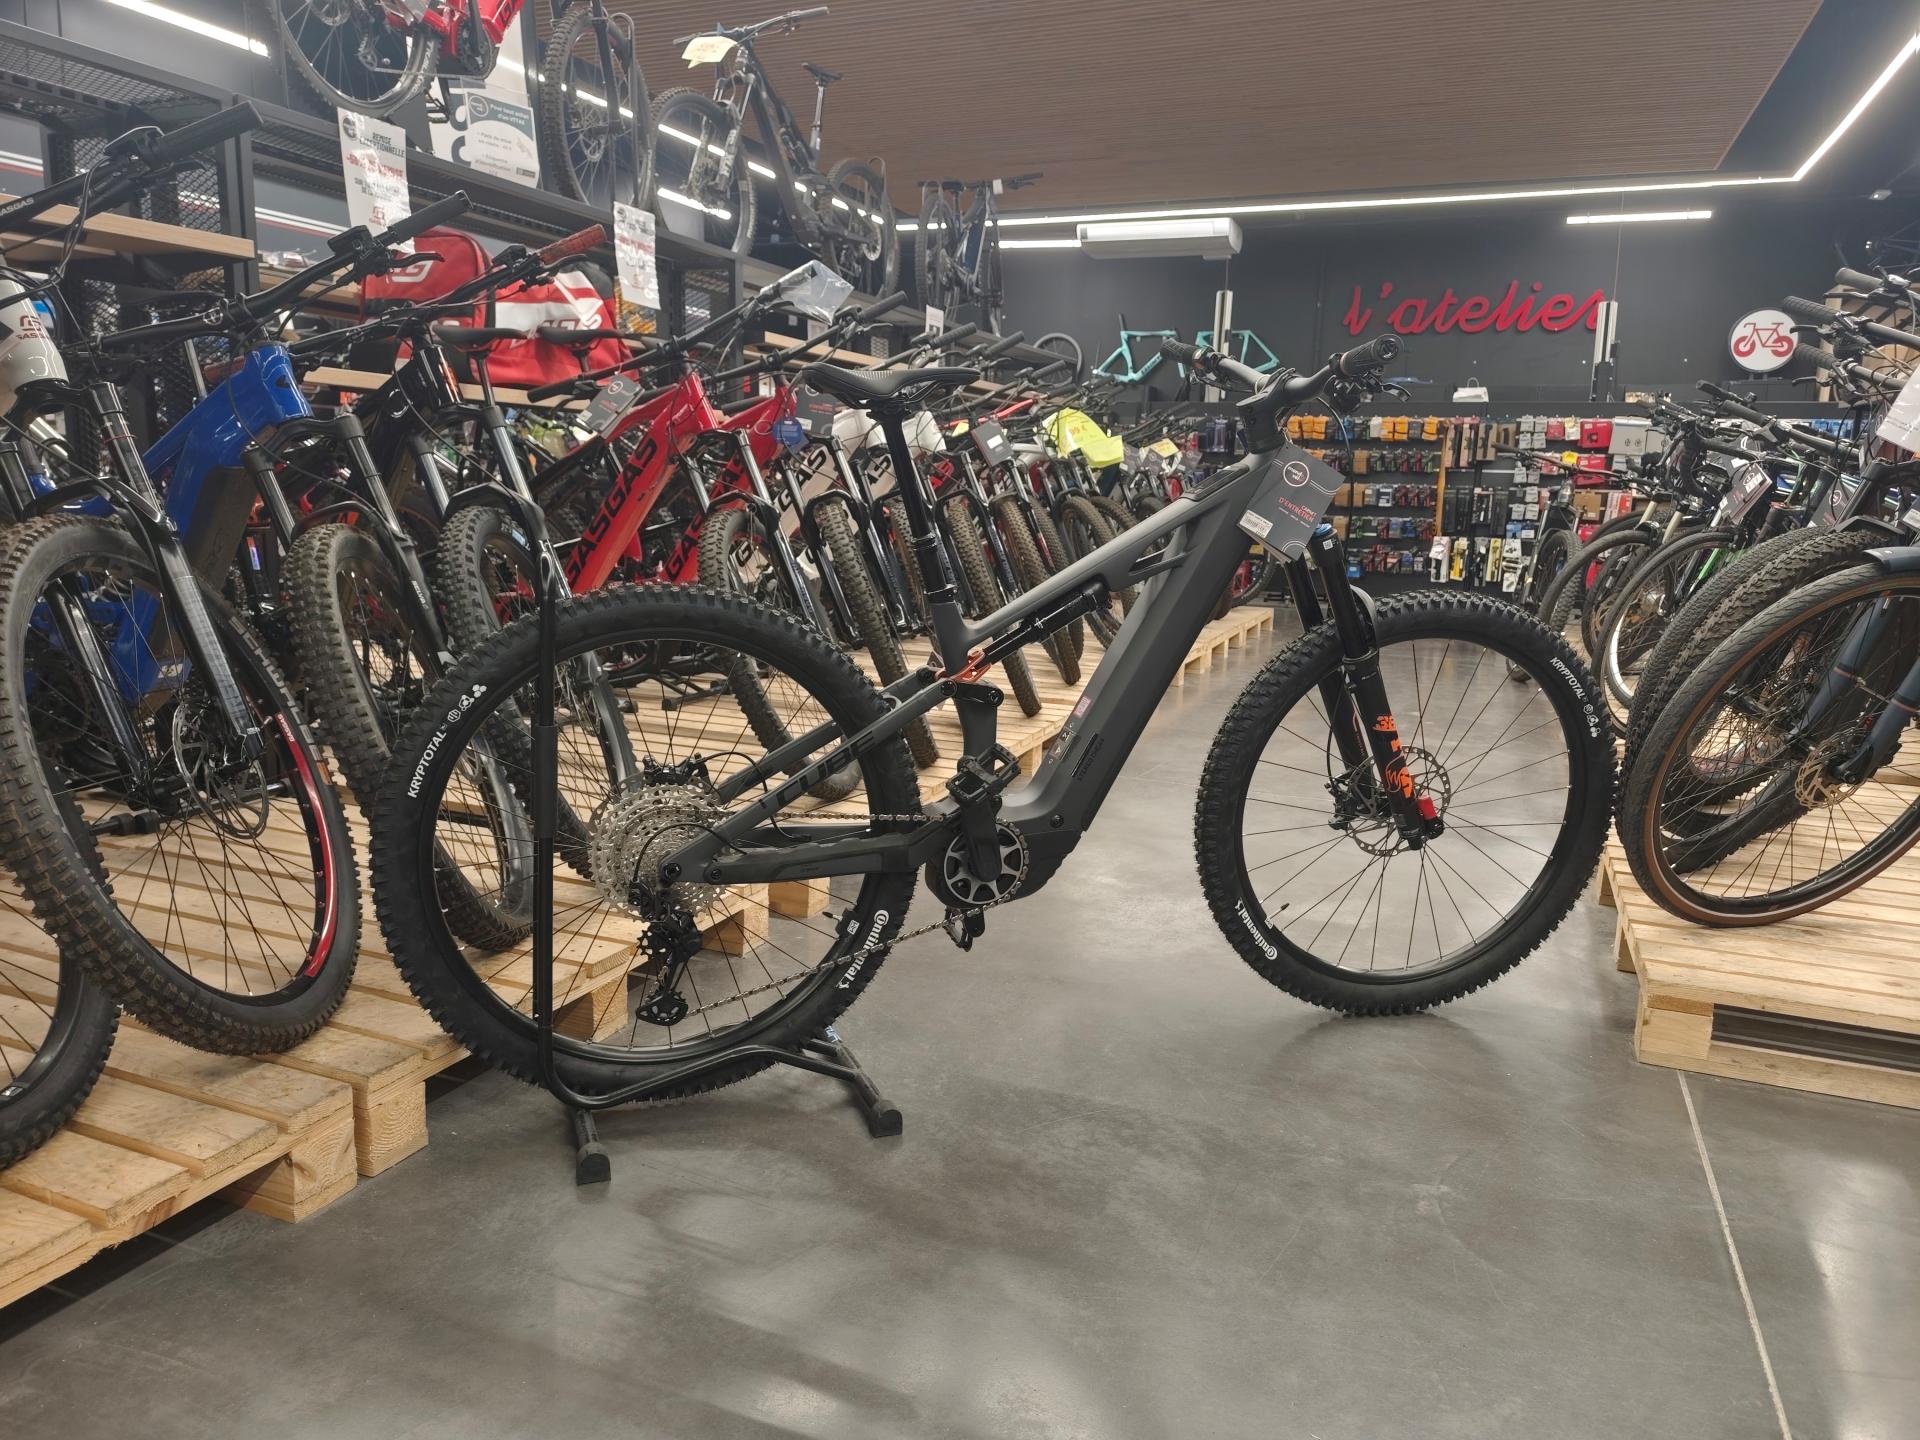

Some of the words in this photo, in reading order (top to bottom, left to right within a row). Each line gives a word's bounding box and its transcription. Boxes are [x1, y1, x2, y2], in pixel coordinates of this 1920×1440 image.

[0, 197, 35, 216] ASGAS
[1343, 279, 1606, 336] l'atelier
[228, 615, 323, 761] SCHWALBE
[1549, 656, 1586, 700] KRYPTOTAL
[407, 731, 448, 799] KRYPTOTAL
[775, 729, 876, 808] CUBE
[843, 908, 891, 983] Continntal
